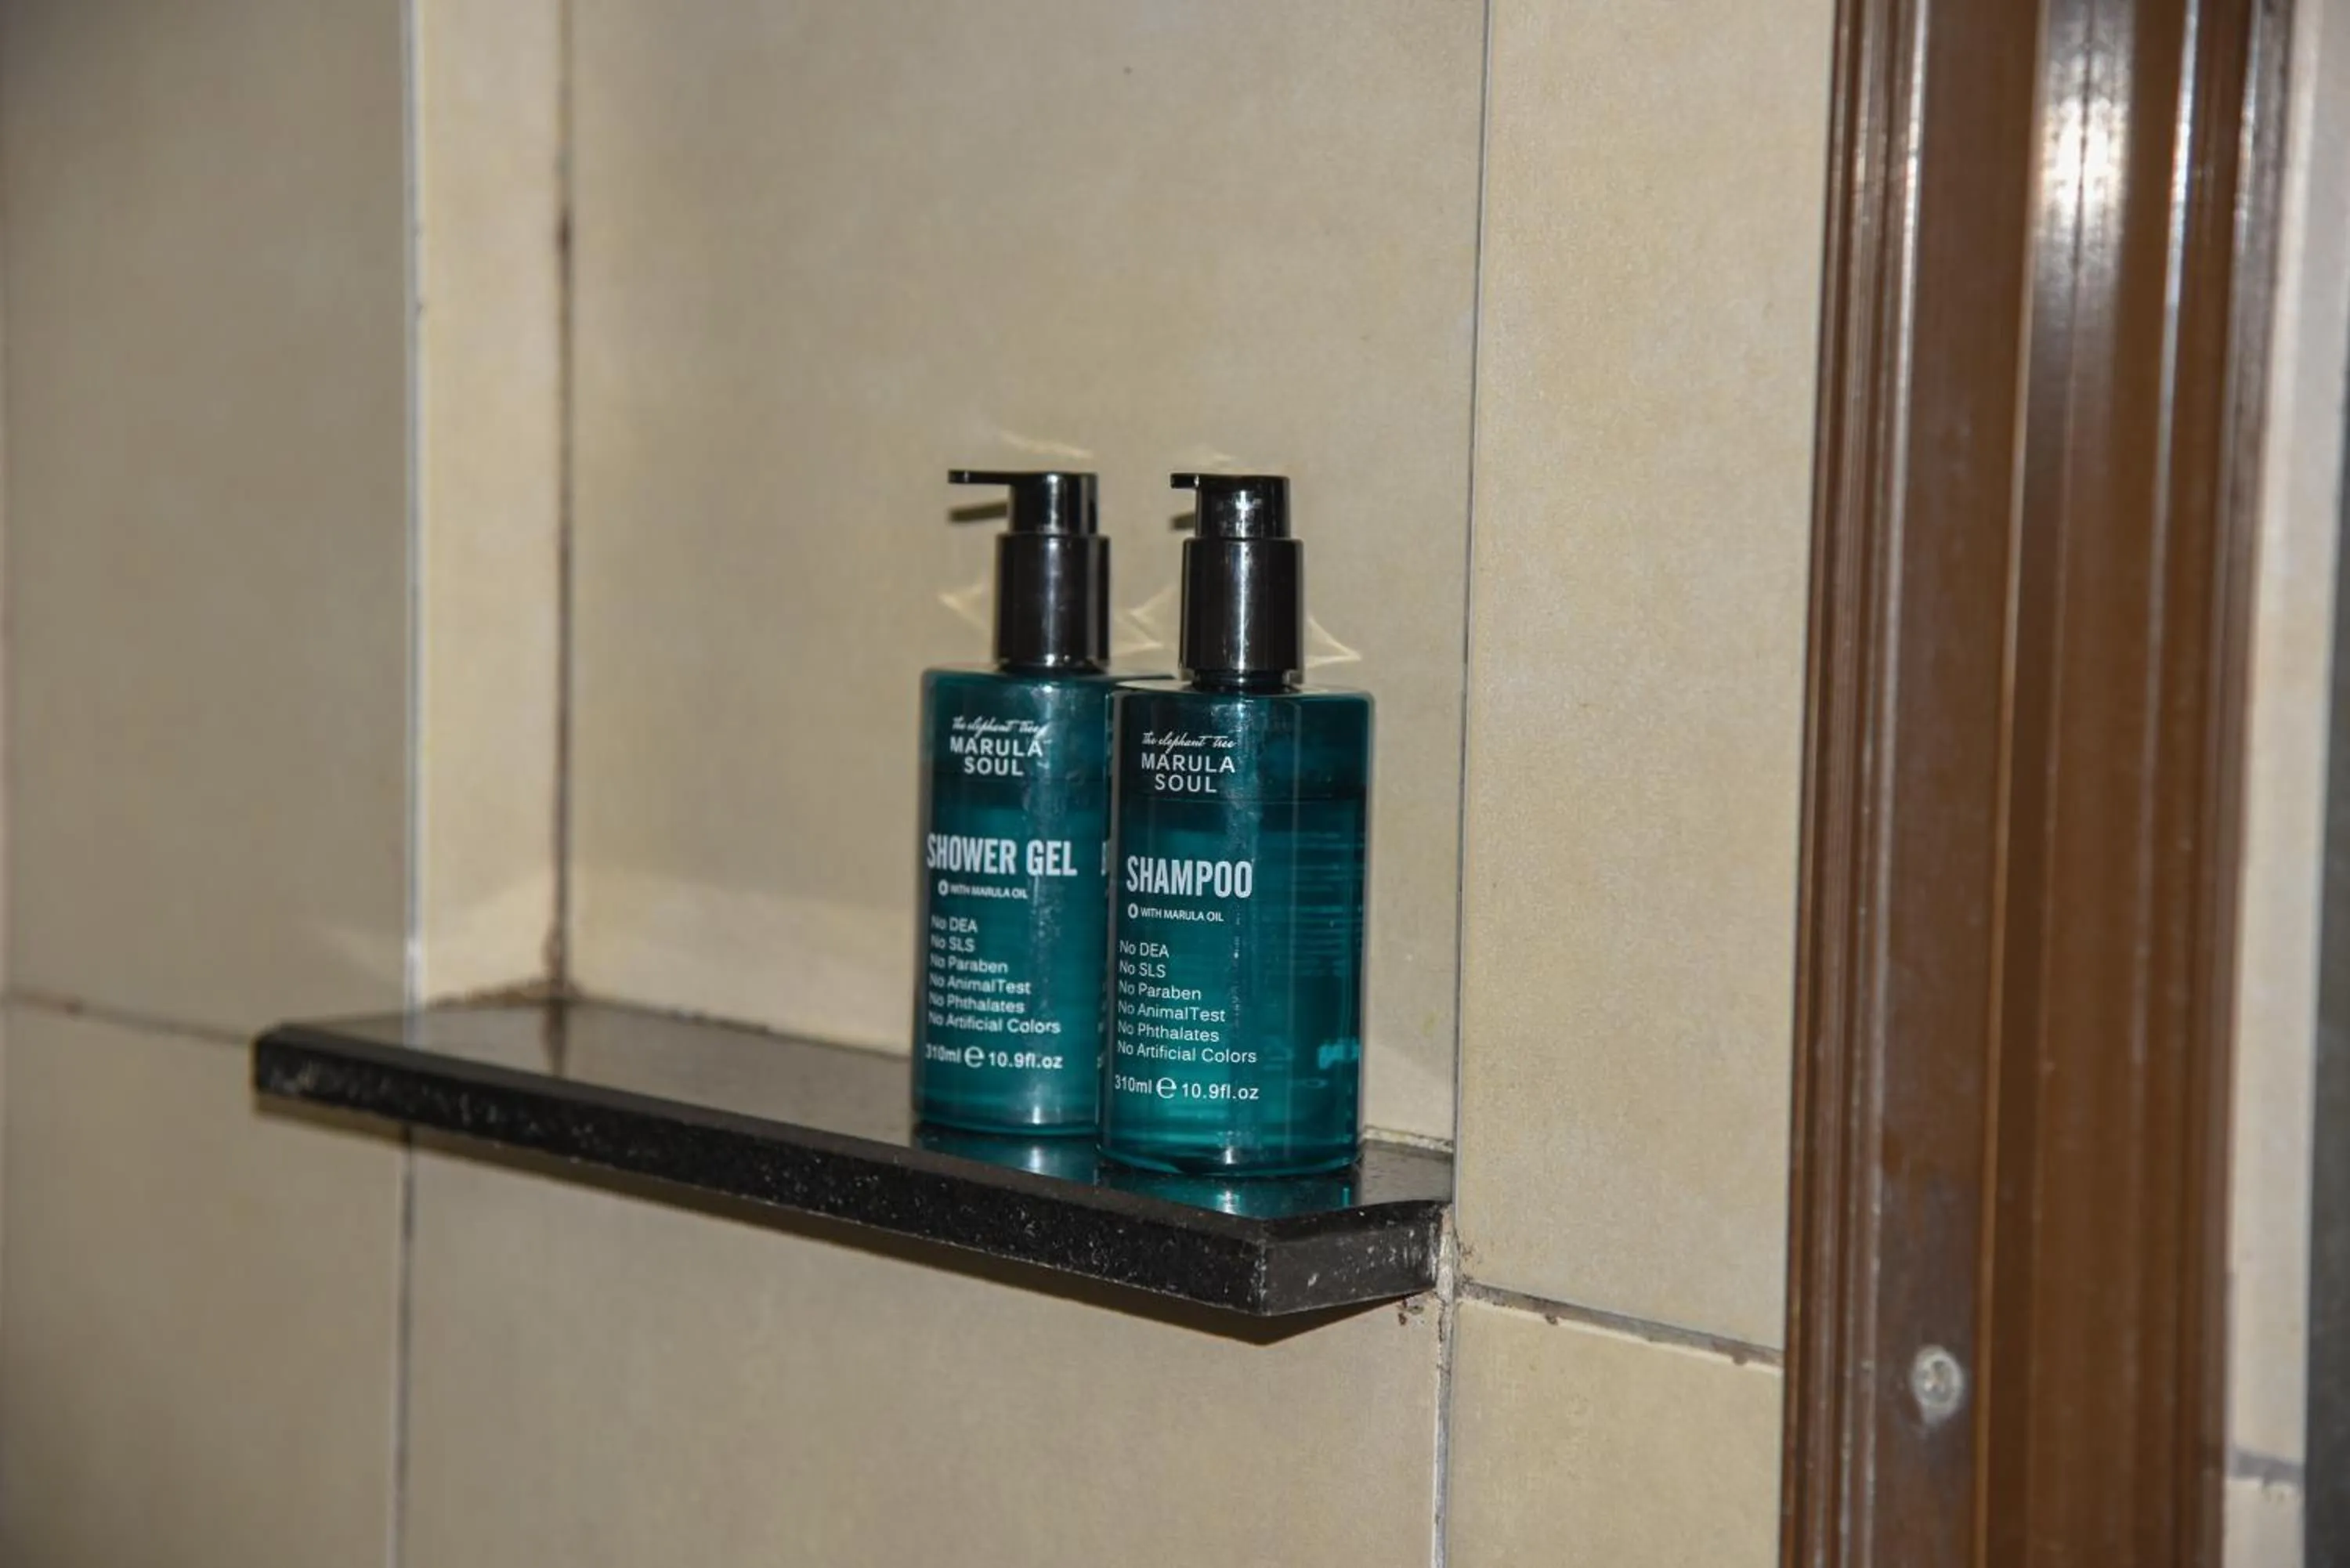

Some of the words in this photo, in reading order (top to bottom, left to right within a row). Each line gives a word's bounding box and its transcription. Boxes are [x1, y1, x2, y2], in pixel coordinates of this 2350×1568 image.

[949, 735, 1043, 757] MARULA
[1158, 731, 1209, 754] elephant
[964, 756, 1025, 776] SOUL
[1141, 751, 1236, 774] MARULA
[1154, 772, 1217, 793] SOUL
[927, 833, 1018, 876] SHOWER
[1026, 839, 1078, 877] GEL
[1126, 854, 1253, 899] SHAMPOO
[931, 914, 947, 930] No
[949, 916, 978, 934] DEA
[1141, 906, 1162, 919] WITH
[1163, 909, 1206, 921] MARULA
[1206, 911, 1224, 922] OIL
[931, 934, 946, 950] No
[949, 936, 975, 953] SLS
[1119, 939, 1137, 956] No
[1139, 941, 1170, 959] DEA
[930, 952, 945, 969] No
[947, 955, 1008, 974] Paraben
[1119, 959, 1136, 976] No
[1138, 962, 1166, 979] SLS
[929, 972, 945, 988] No
[1119, 979, 1135, 995] No
[1138, 982, 1202, 1001] Paraben
[928, 992, 944, 1007] No
[946, 993, 1025, 1014] Phthalates
[1118, 999, 1134, 1016] No
[928, 1010, 943, 1027] No
[945, 1013, 1003, 1032] Artificial
[1007, 1017, 1062, 1035] Colors
[1118, 1019, 1134, 1035] No
[1137, 1021, 1220, 1042] Phthalates
[925, 1043, 962, 1064] 310ml
[987, 1051, 1064, 1071] 10.9fl.oz
[1117, 1039, 1133, 1056] No
[1137, 1042, 1196, 1062] Artificial
[1201, 1047, 1258, 1064] Colors
[1114, 1074, 1152, 1094] 310ml
[1181, 1082, 1260, 1101] 10.9fl.oz
